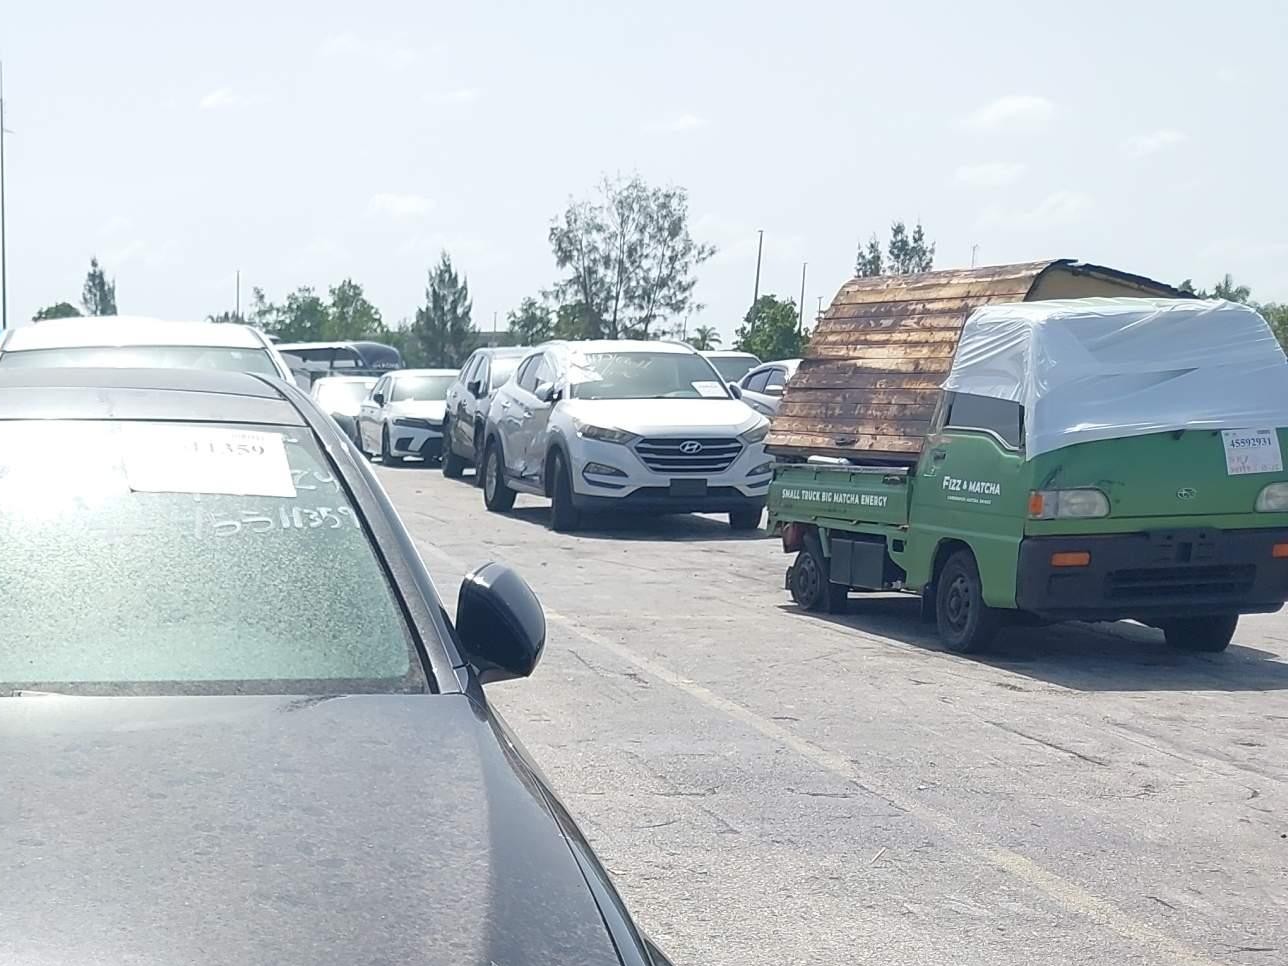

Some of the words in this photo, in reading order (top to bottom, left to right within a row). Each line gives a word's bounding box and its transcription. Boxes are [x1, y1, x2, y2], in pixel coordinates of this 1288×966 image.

[1230, 437, 1272, 448] 45592931
[968, 480, 1001, 496] MATCHA
[781, 488, 800, 500] SMALL
[801, 490, 820, 502] TRUCK
[821, 492, 832, 502] BIG
[833, 493, 859, 505] MATCHA
[860, 494, 888, 507] ENERGY
